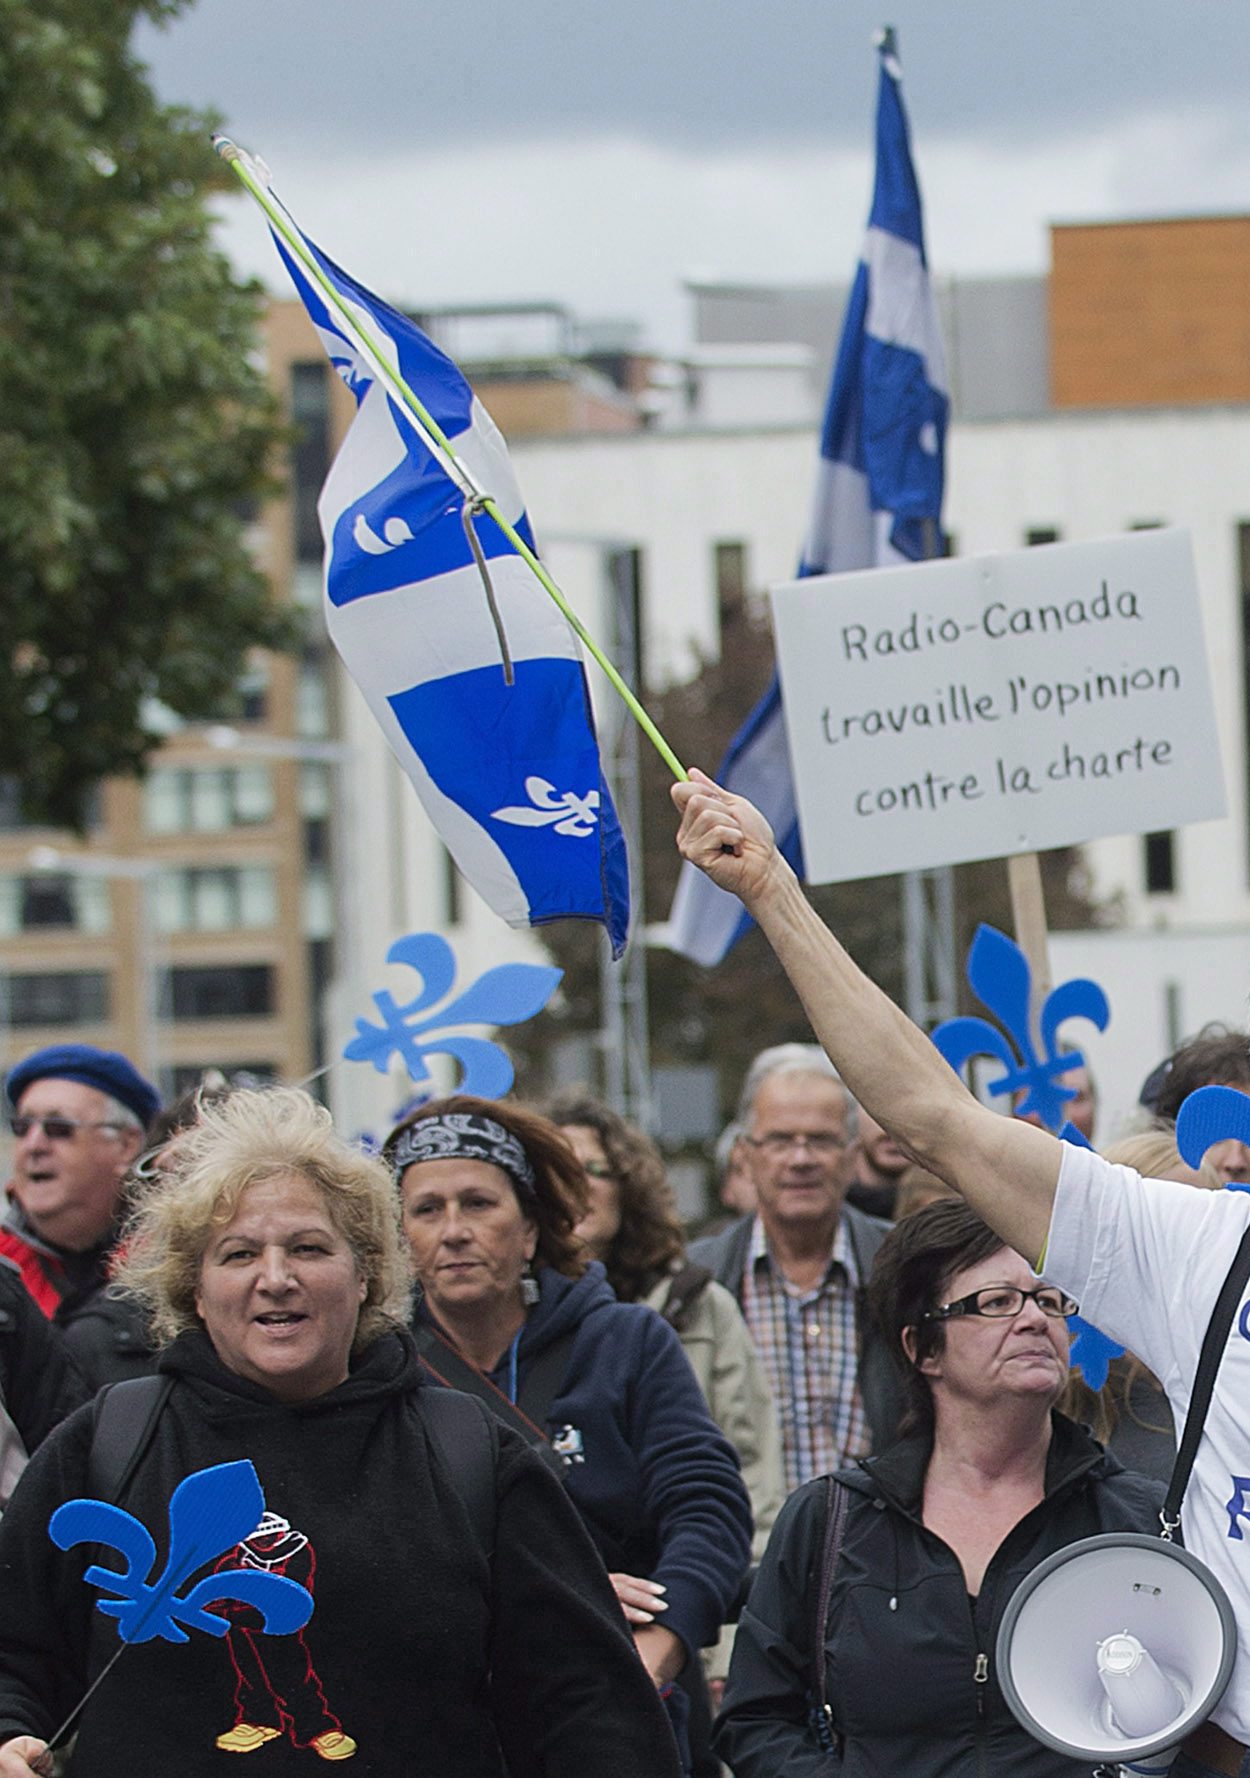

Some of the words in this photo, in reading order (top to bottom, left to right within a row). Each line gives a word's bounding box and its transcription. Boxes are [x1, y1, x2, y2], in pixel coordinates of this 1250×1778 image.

[841, 580, 1143, 662] Radio-Canada
[821, 684, 999, 744] travaille
[1009, 664, 1180, 717] l'opinion
[856, 771, 984, 816] contre
[996, 758, 1041, 795] la
[1048, 737, 1173, 782] charte
